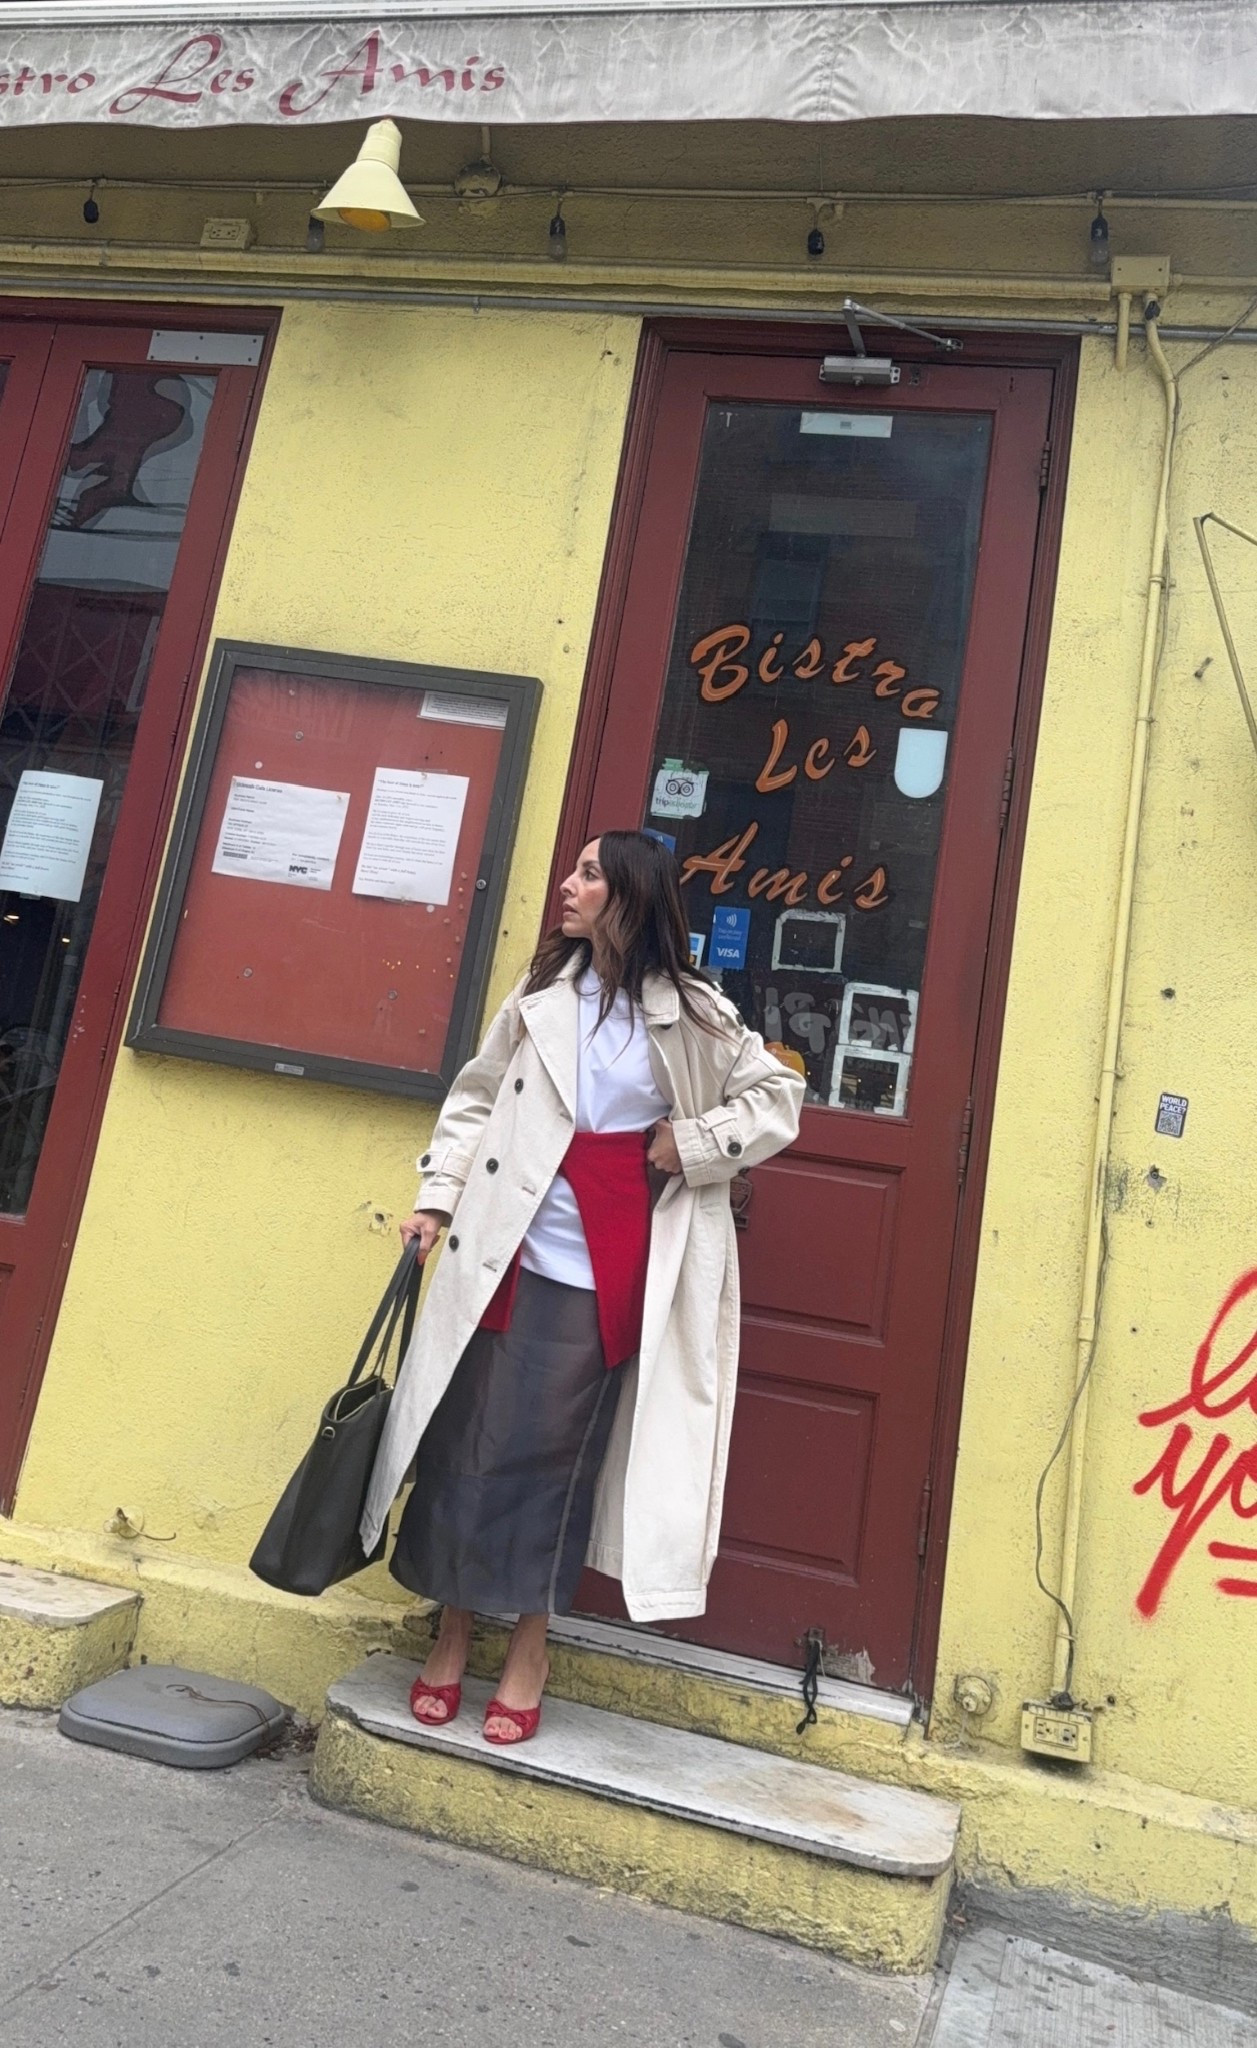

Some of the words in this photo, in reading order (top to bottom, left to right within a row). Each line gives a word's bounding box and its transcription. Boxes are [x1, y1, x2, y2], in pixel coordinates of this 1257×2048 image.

[109, 34, 256, 115] Les
[278, 29, 506, 117] Amis
[755, 719, 877, 793] Les
[679, 821, 888, 909] Amis
[716, 947, 740, 959] VISA
[1160, 1102, 1187, 1114] PEACE?
[1161, 1094, 1187, 1107] WORLD
